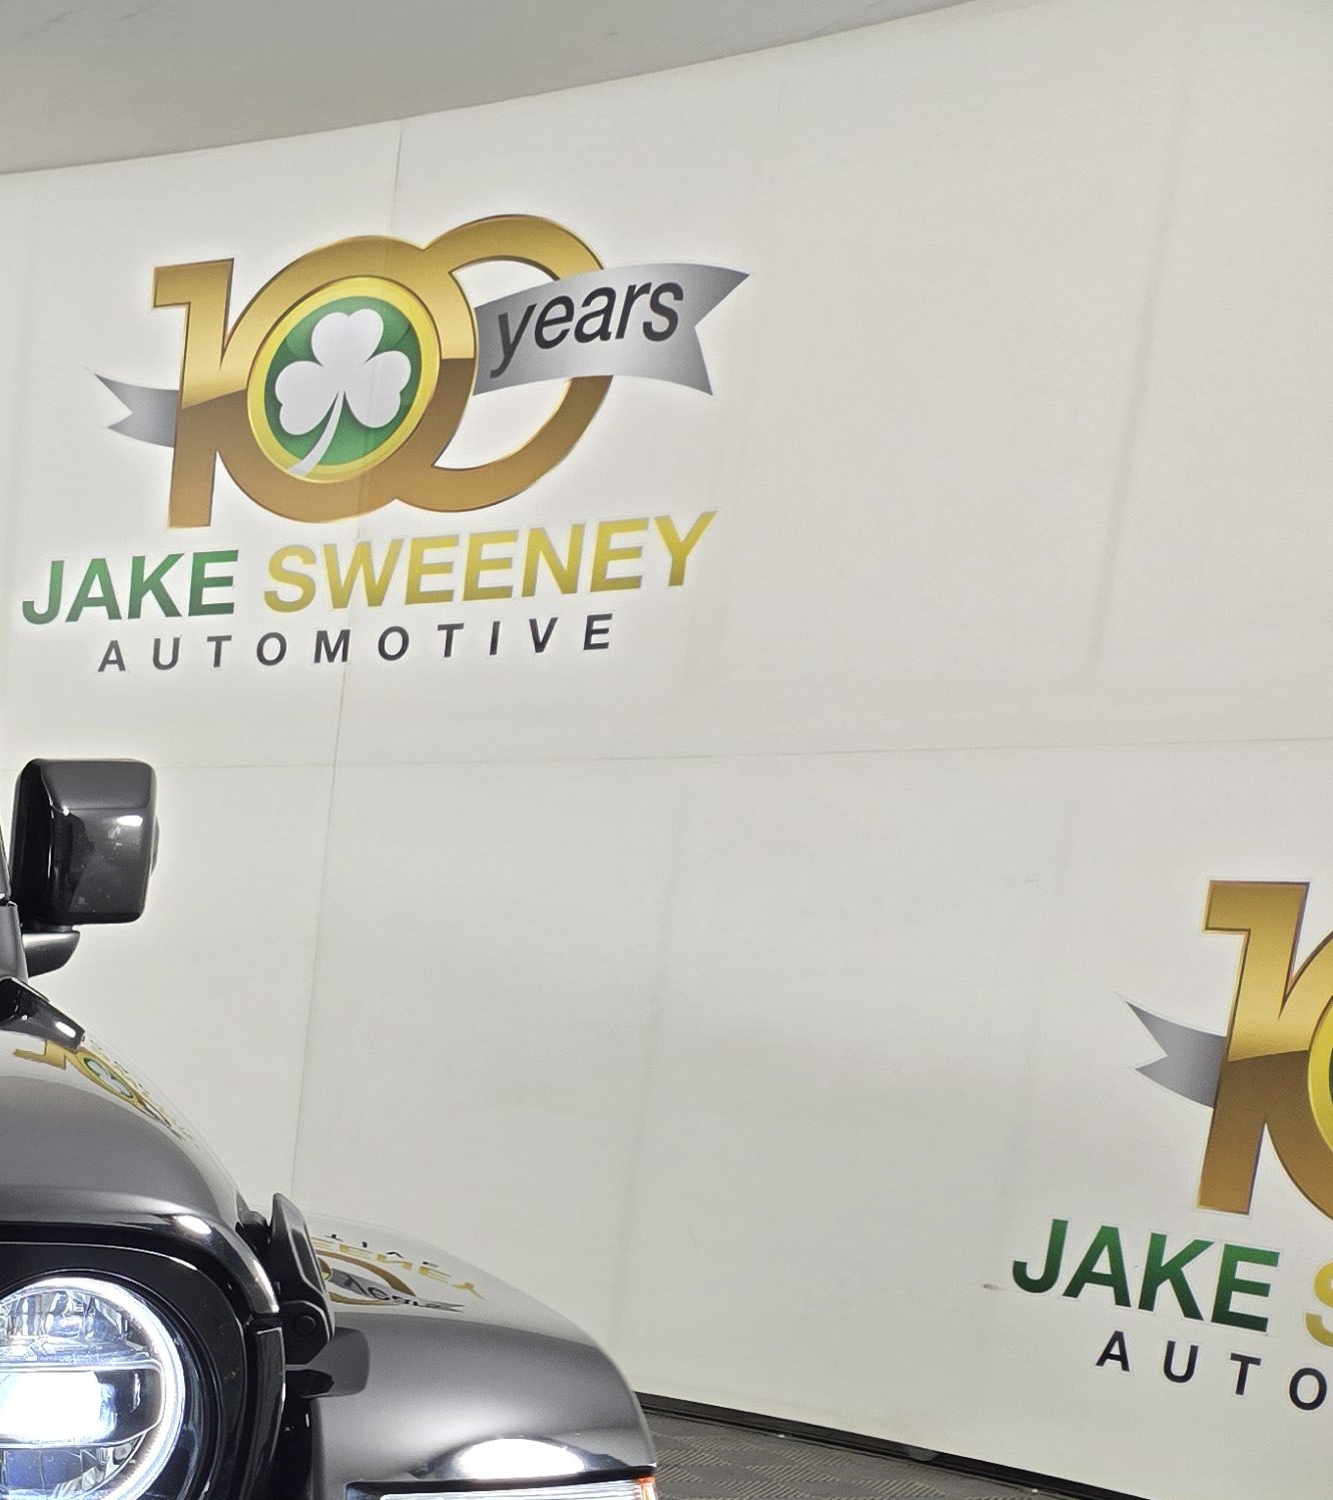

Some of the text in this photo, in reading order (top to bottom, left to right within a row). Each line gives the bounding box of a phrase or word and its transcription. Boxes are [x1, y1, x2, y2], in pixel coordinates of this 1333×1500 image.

[489, 280, 684, 379] years
[22, 510, 718, 626] JAKE SWEENEY
[97, 613, 614, 674] AUTOMOTIVE
[1011, 1217, 1281, 1333] JAKE
[1095, 1329, 1328, 1411] AUTO
